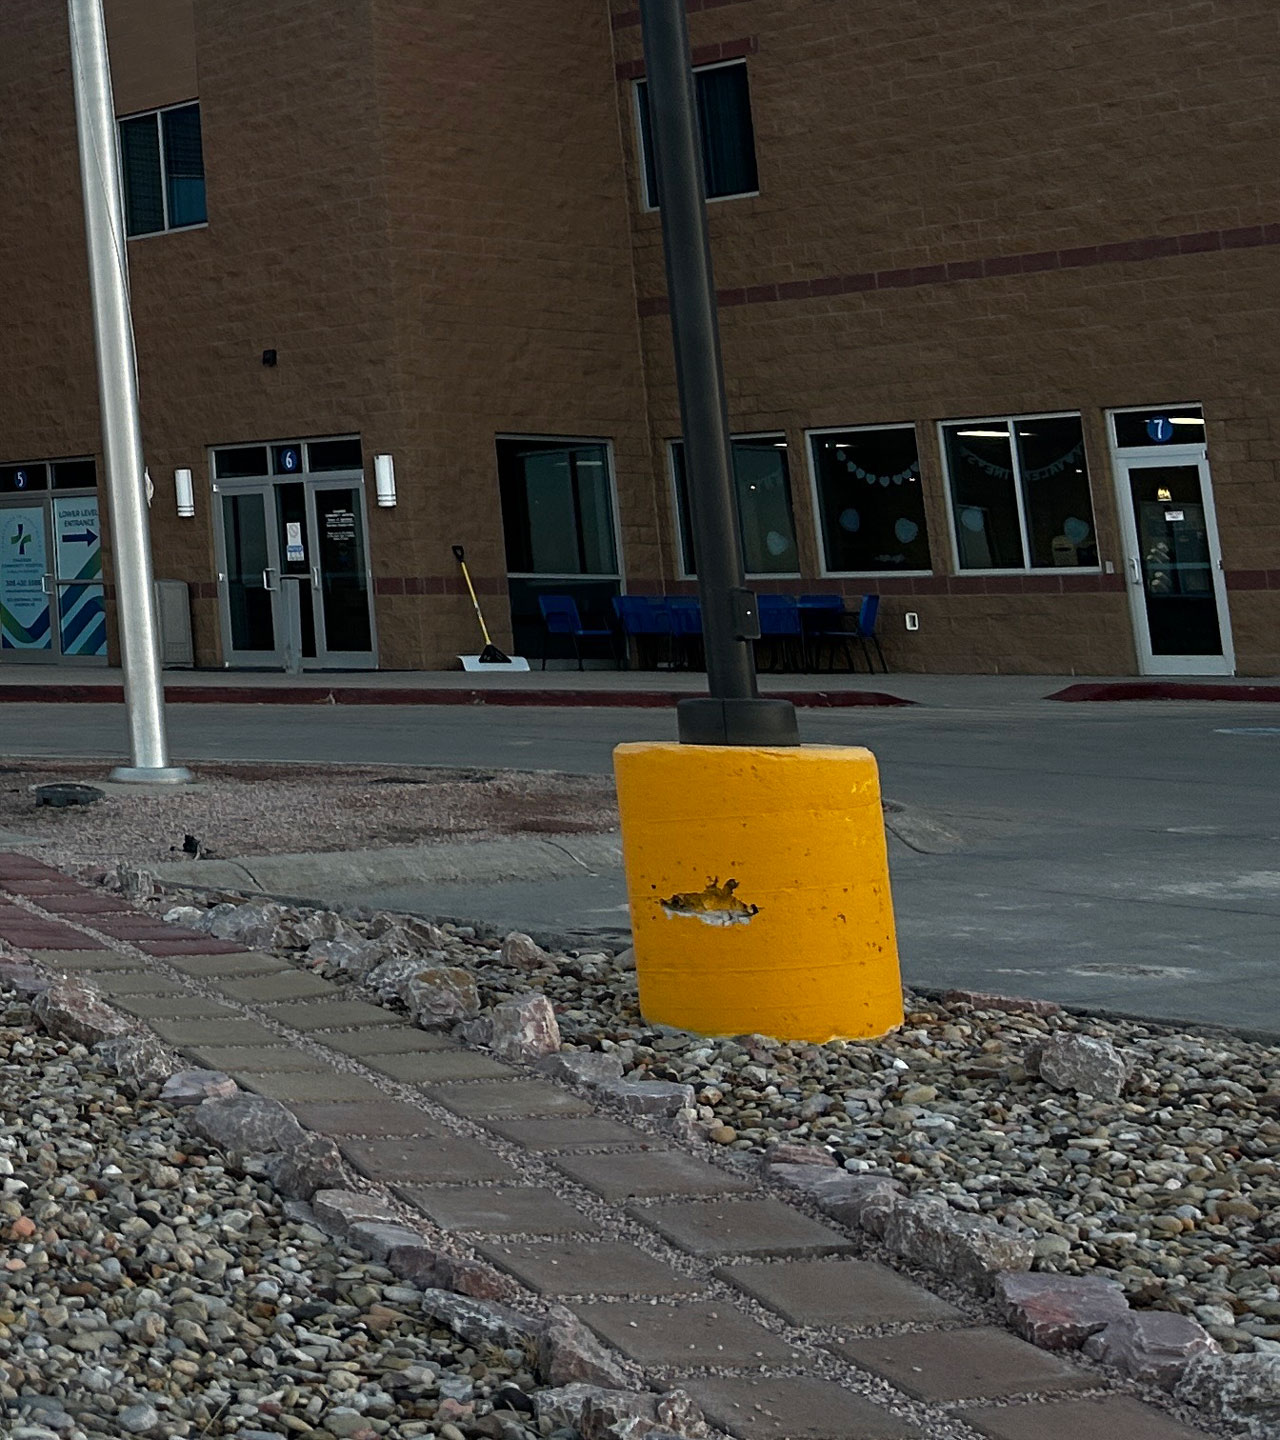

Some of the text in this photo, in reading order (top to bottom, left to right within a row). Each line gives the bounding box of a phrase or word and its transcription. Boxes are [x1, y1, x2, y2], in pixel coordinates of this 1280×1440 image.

[1153, 419, 1164, 440] 7
[285, 451, 294, 469] 6
[17, 471, 24, 488] 5
[58, 508, 98, 519] LOWER LEVEL
[64, 519, 95, 528] ENTRANCE
